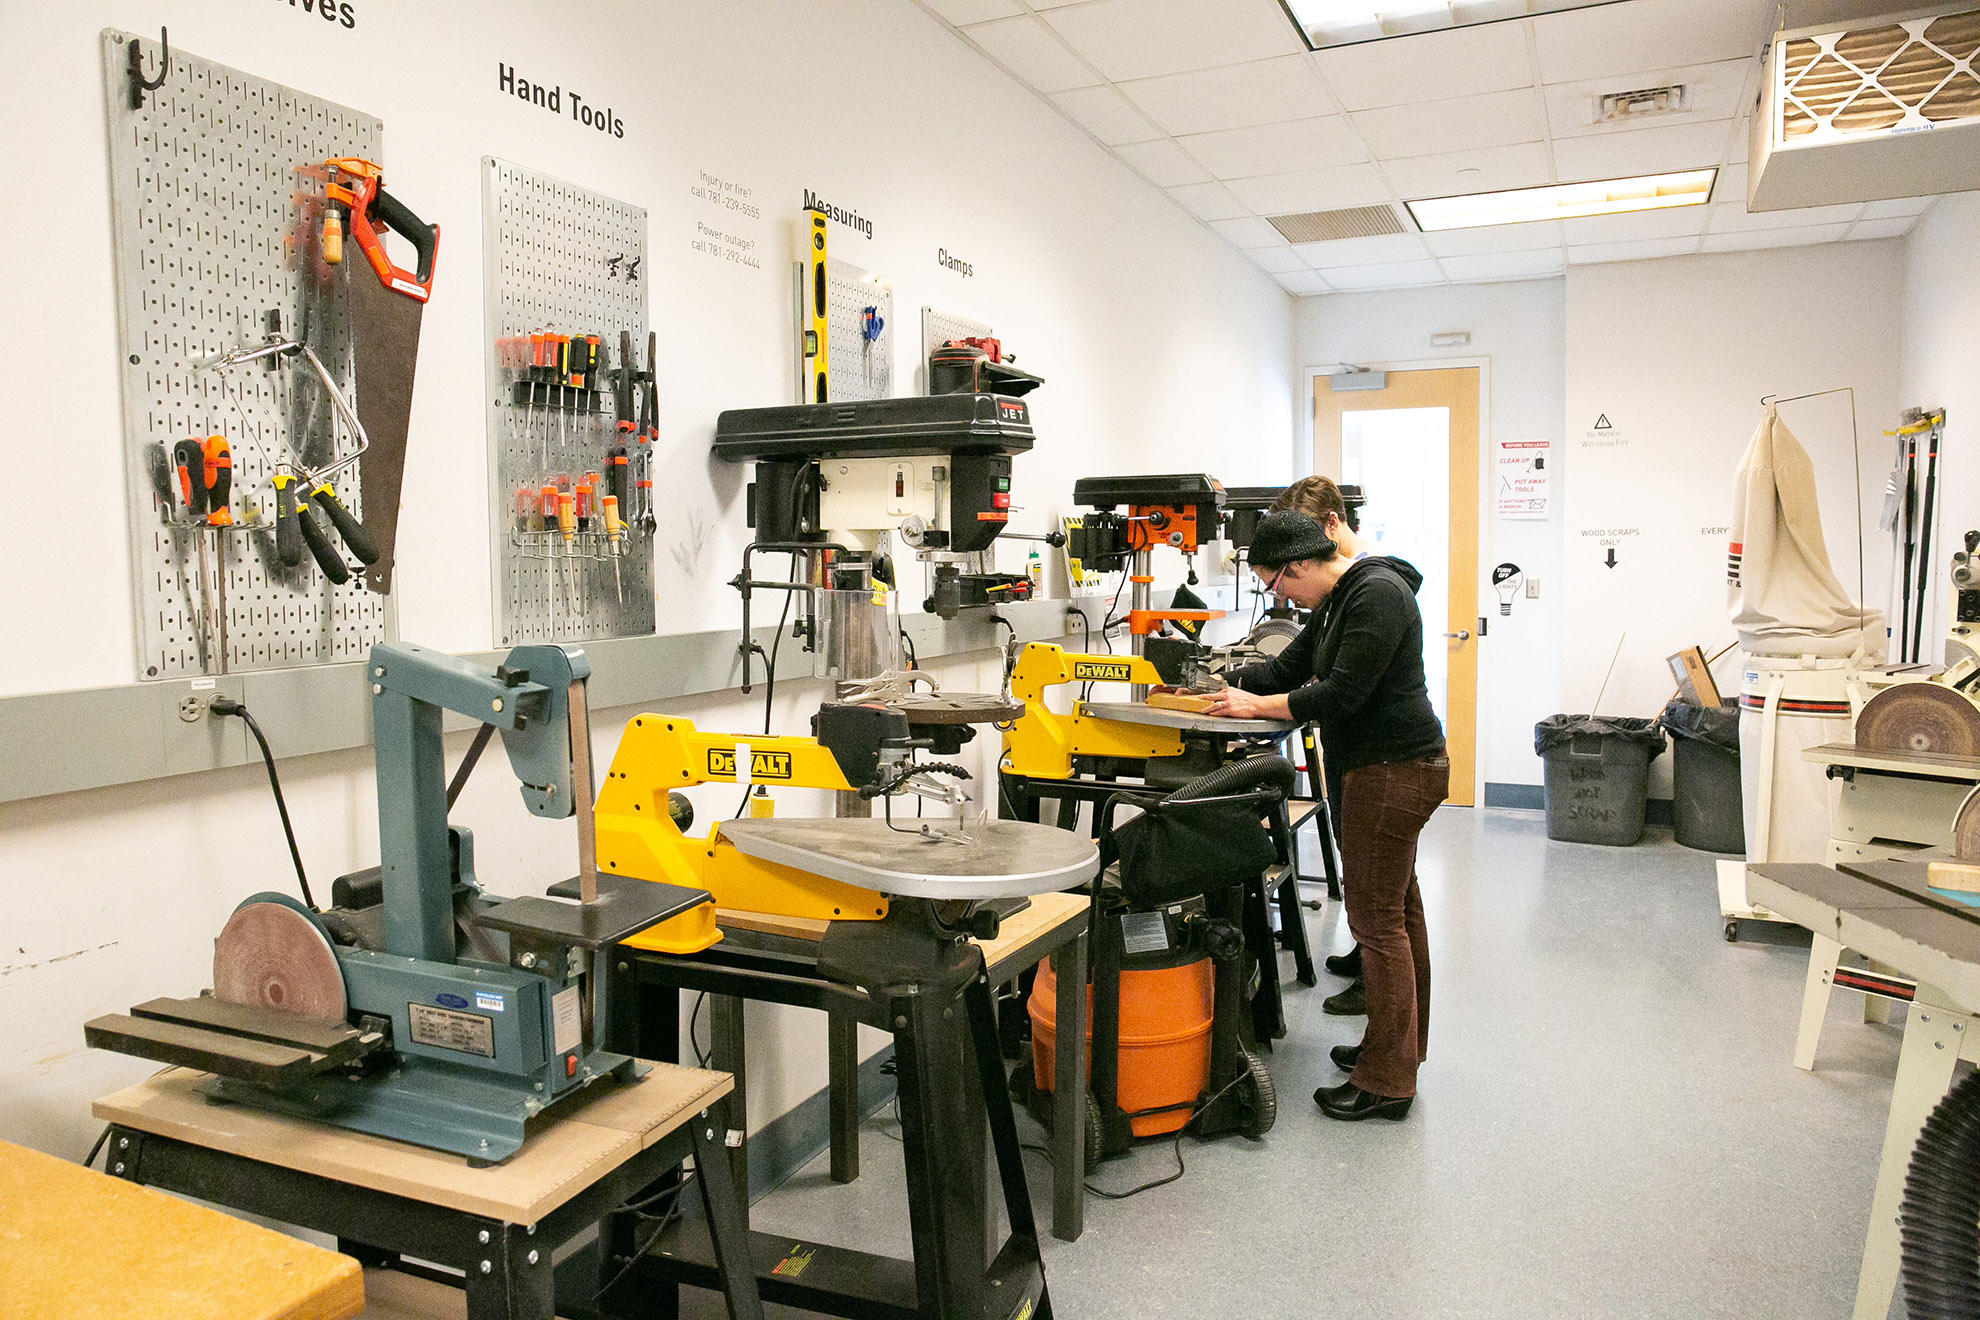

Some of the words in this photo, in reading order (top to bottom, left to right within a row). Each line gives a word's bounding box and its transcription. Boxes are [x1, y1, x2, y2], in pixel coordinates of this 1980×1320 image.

[499, 62, 561, 114] Hand
[568, 91, 624, 139] Tools
[699, 168, 723, 191] Injury
[724, 182, 733, 192] or
[735, 183, 752, 199] fire?
[691, 185, 706, 200] call
[707, 189, 760, 220] 781-239-5555
[803, 188, 873, 241] Measuring
[697, 221, 723, 240] Power
[724, 234, 756, 252] outage?
[691, 239, 707, 254] call
[708, 242, 761, 270] 781-292-4444
[938, 247, 974, 279] Clamps
[1002, 408, 1025, 421] JET
[1581, 529, 1606, 537] WOOD
[1607, 528, 1640, 536] SCRAPS
[1599, 538, 1621, 546] ONLY
[1701, 526, 1730, 535] EVERY
